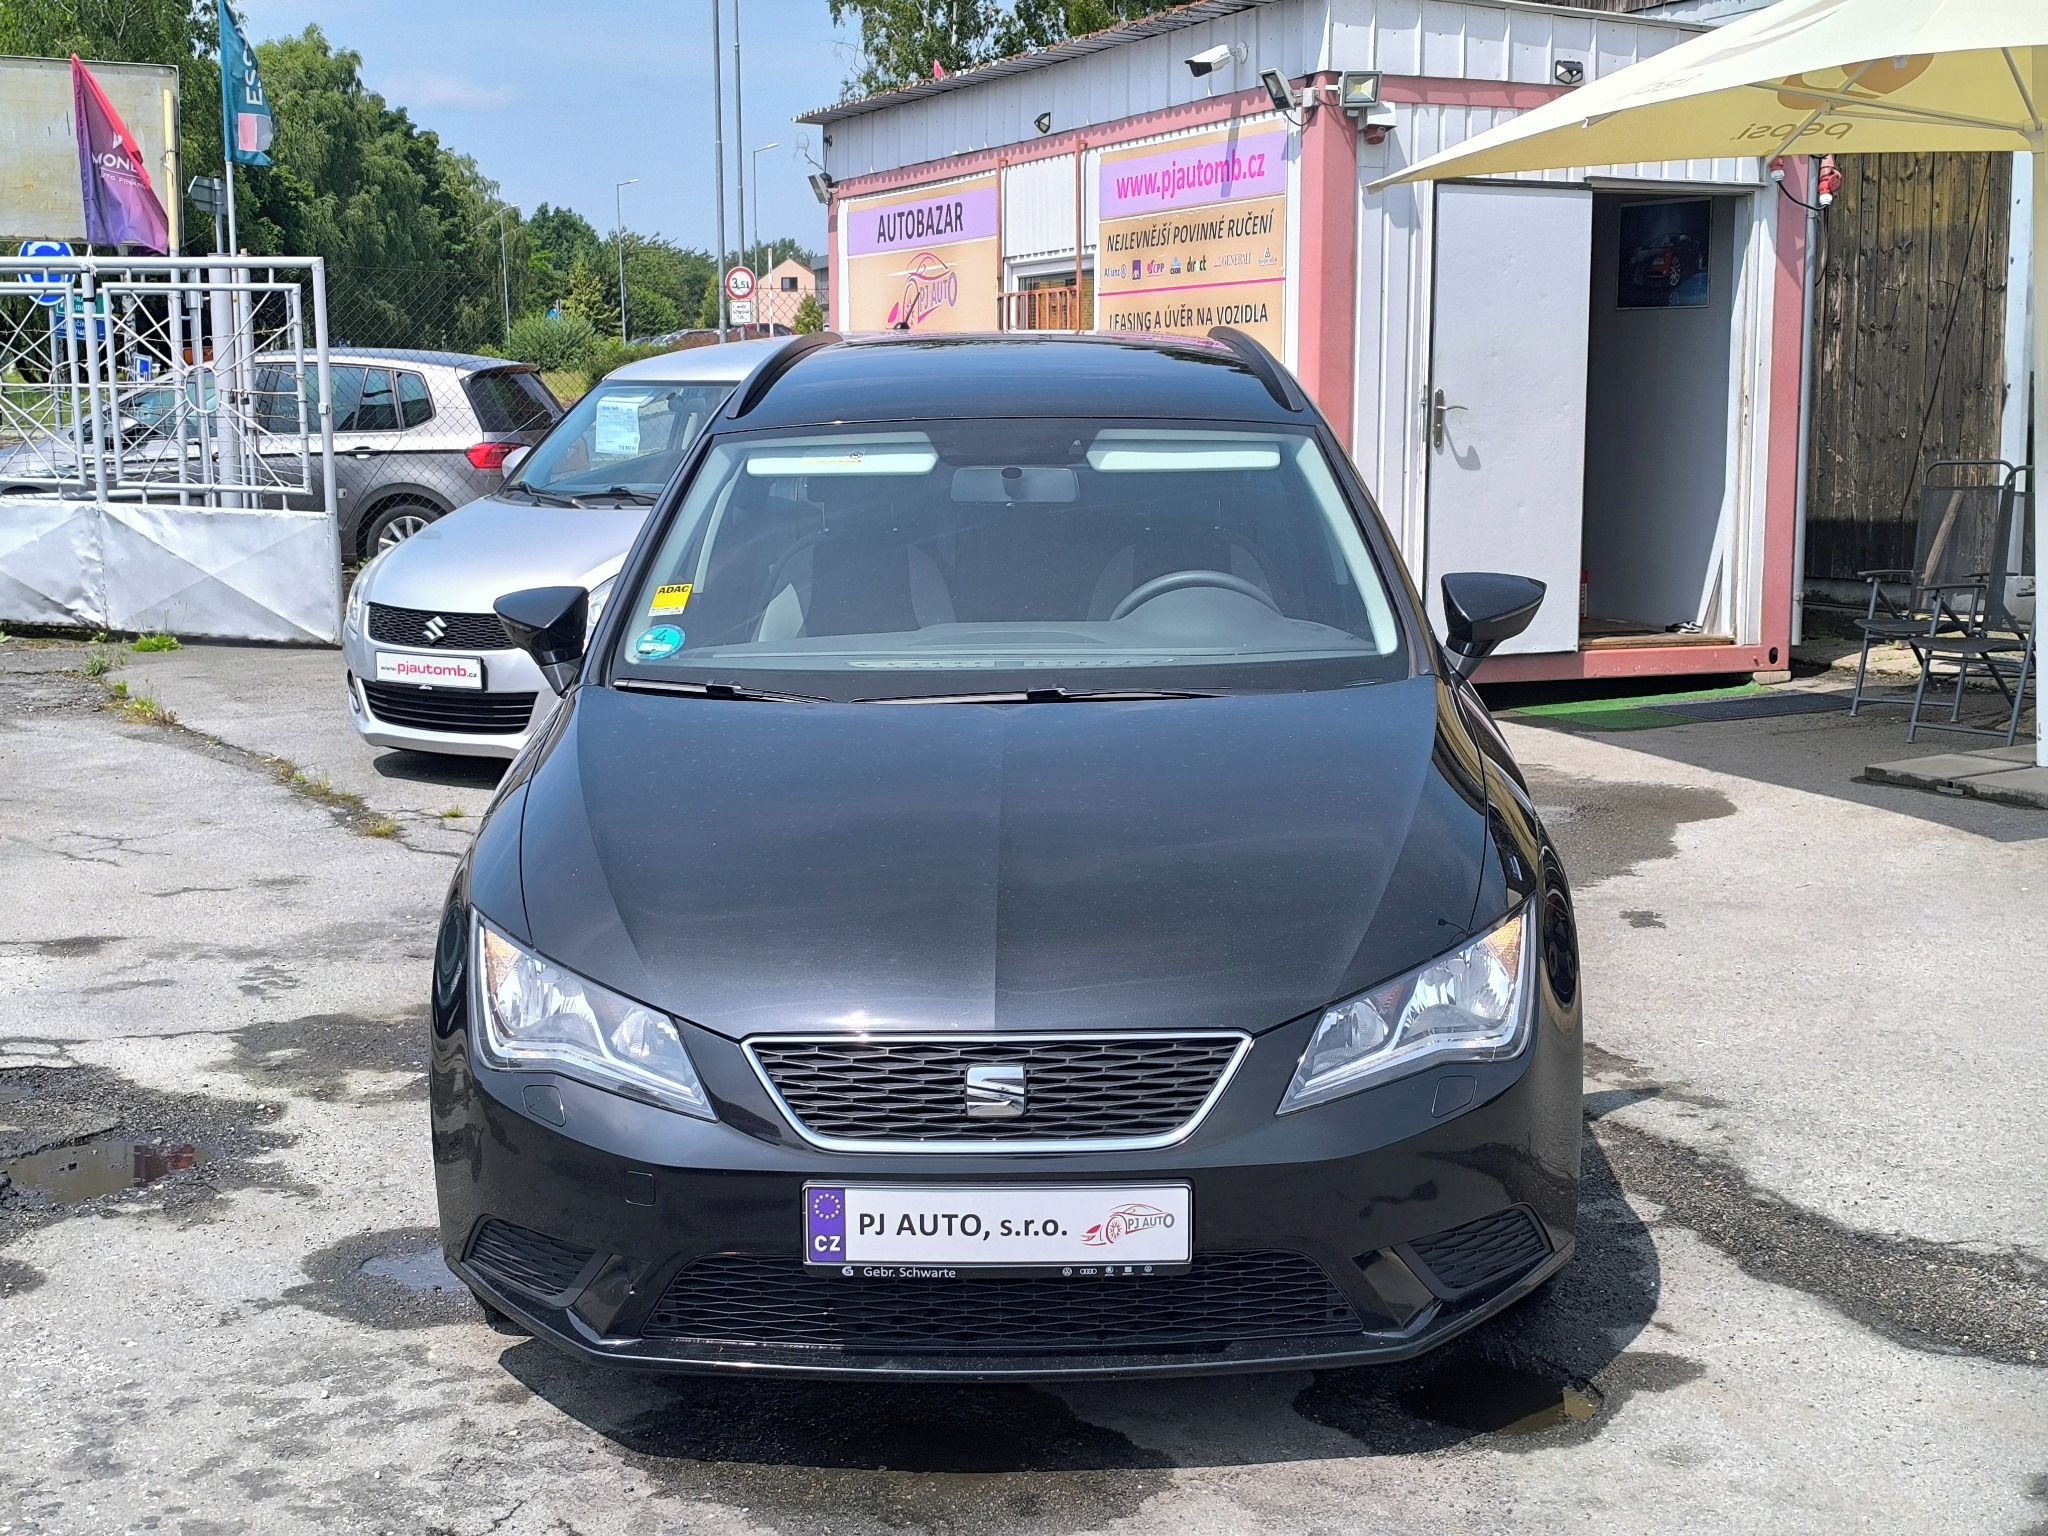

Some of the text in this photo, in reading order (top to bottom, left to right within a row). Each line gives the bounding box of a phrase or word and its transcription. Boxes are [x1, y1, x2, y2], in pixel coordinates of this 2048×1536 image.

[1116, 149, 1265, 199] www.pjautomb.cz
[877, 202, 963, 243] AUTOBAZAR
[1107, 208, 1275, 252] NEJLEVNĚJŠÍ POVINNÉ RUČENÍ
[931, 271, 958, 307] AUTO
[1154, 310, 1162, 329] A
[1164, 304, 1193, 328] ÚVĚR
[1196, 307, 1213, 326] NA
[1216, 303, 1268, 325] VOZIDLA
[657, 585, 690, 594] ADAC
[654, 629, 668, 642] 4
[858, 1213, 1068, 1241] PJ AUTO, s.r.o.
[1128, 1213, 1175, 1230] PJ AUTO
[814, 1235, 841, 1252] CZ
[863, 1266, 956, 1278] Gebr. Schwarte
